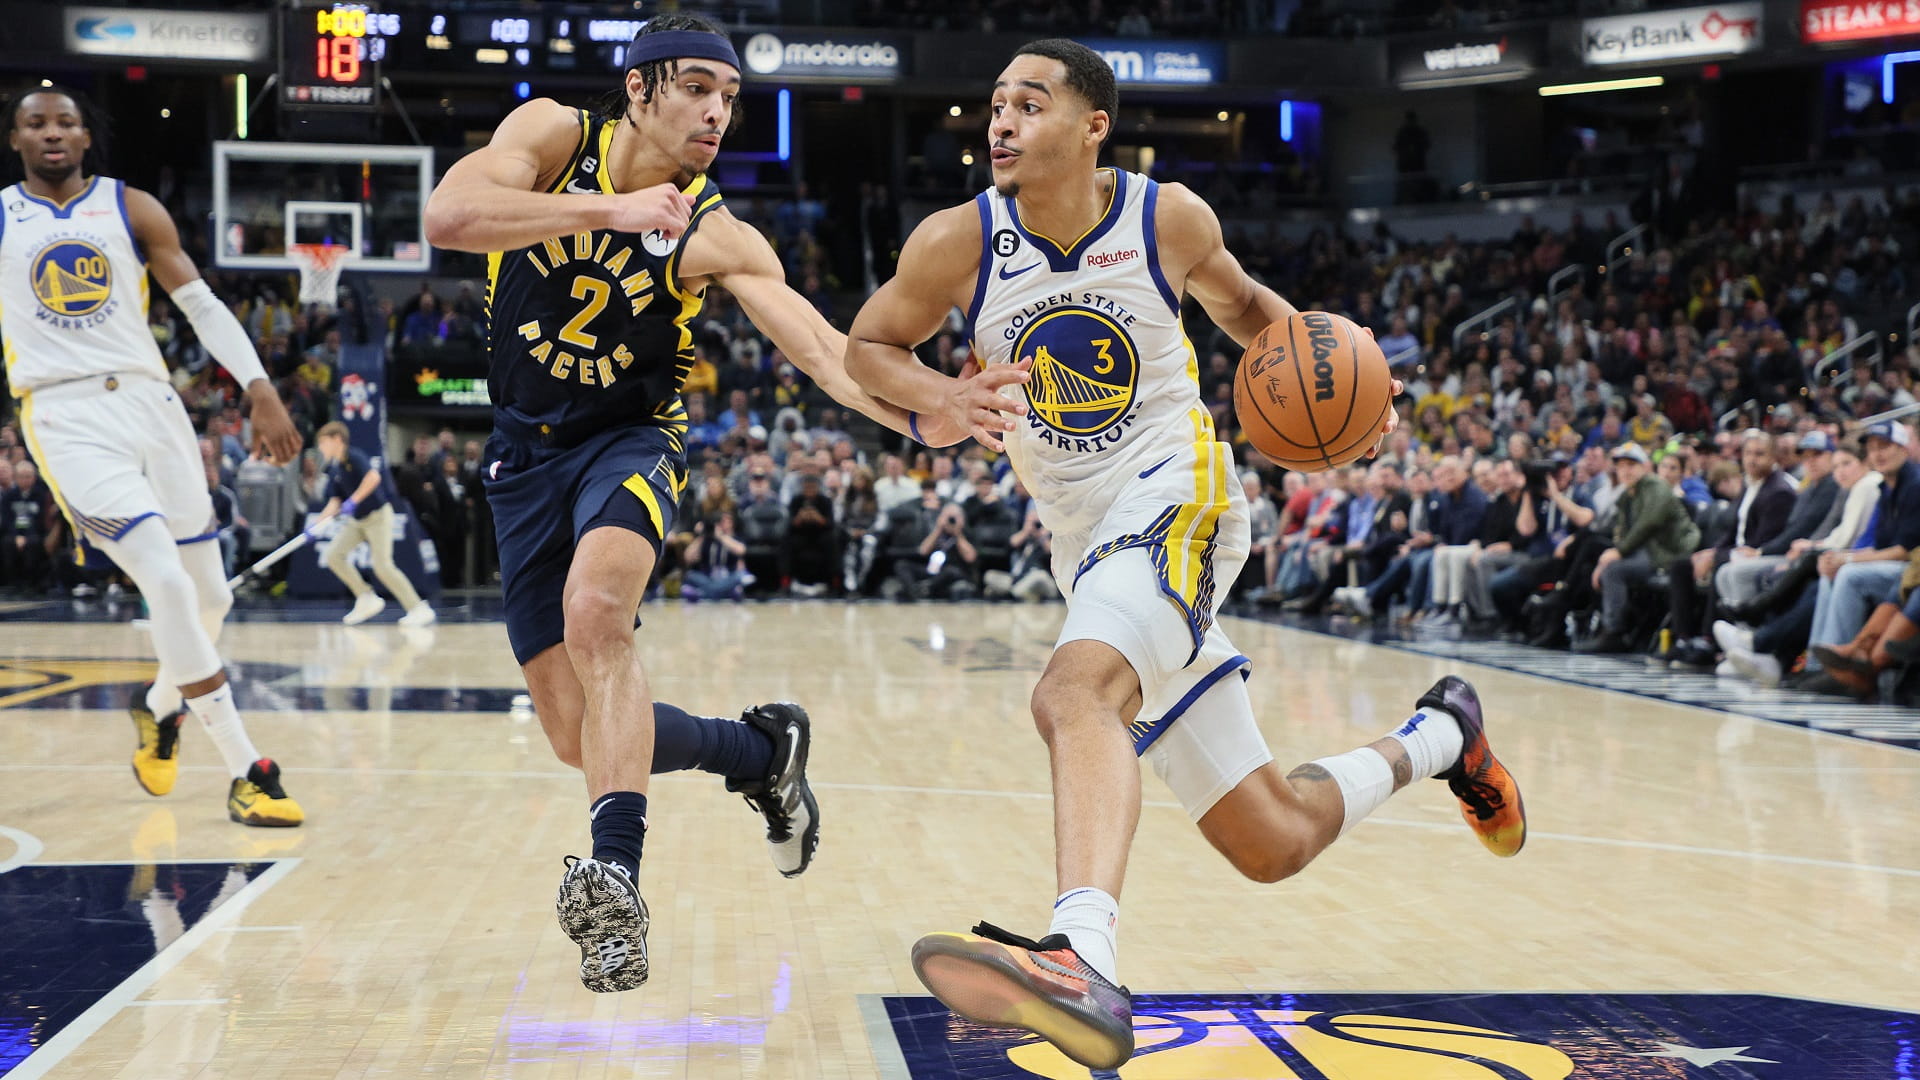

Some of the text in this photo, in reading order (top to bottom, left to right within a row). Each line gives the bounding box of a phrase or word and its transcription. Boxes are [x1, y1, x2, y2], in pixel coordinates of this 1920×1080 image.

[150, 19, 260, 46] Kinetico
[317, 9, 366, 37] 1:00
[1806, 1, 1884, 33] STEAK
[1585, 20, 1695, 54] KeyBank
[318, 36, 360, 81] 18
[785, 40, 898, 67] motorola
[1424, 43, 1500, 71] verizon
[311, 87, 373, 103] TISSOT
[581, 156, 598, 174] 6
[998, 233, 1015, 252] 6
[1087, 249, 1139, 267] Rakuten
[74, 256, 105, 280] 00
[527, 230, 655, 317] INDIANA
[35, 299, 119, 330] WARRIORS
[558, 275, 611, 350] 2
[1004, 292, 1137, 341] GOLDEN STATE
[518, 320, 635, 389] PACERS
[1091, 338, 1115, 375] 3
[1301, 313, 1340, 403] Wilson
